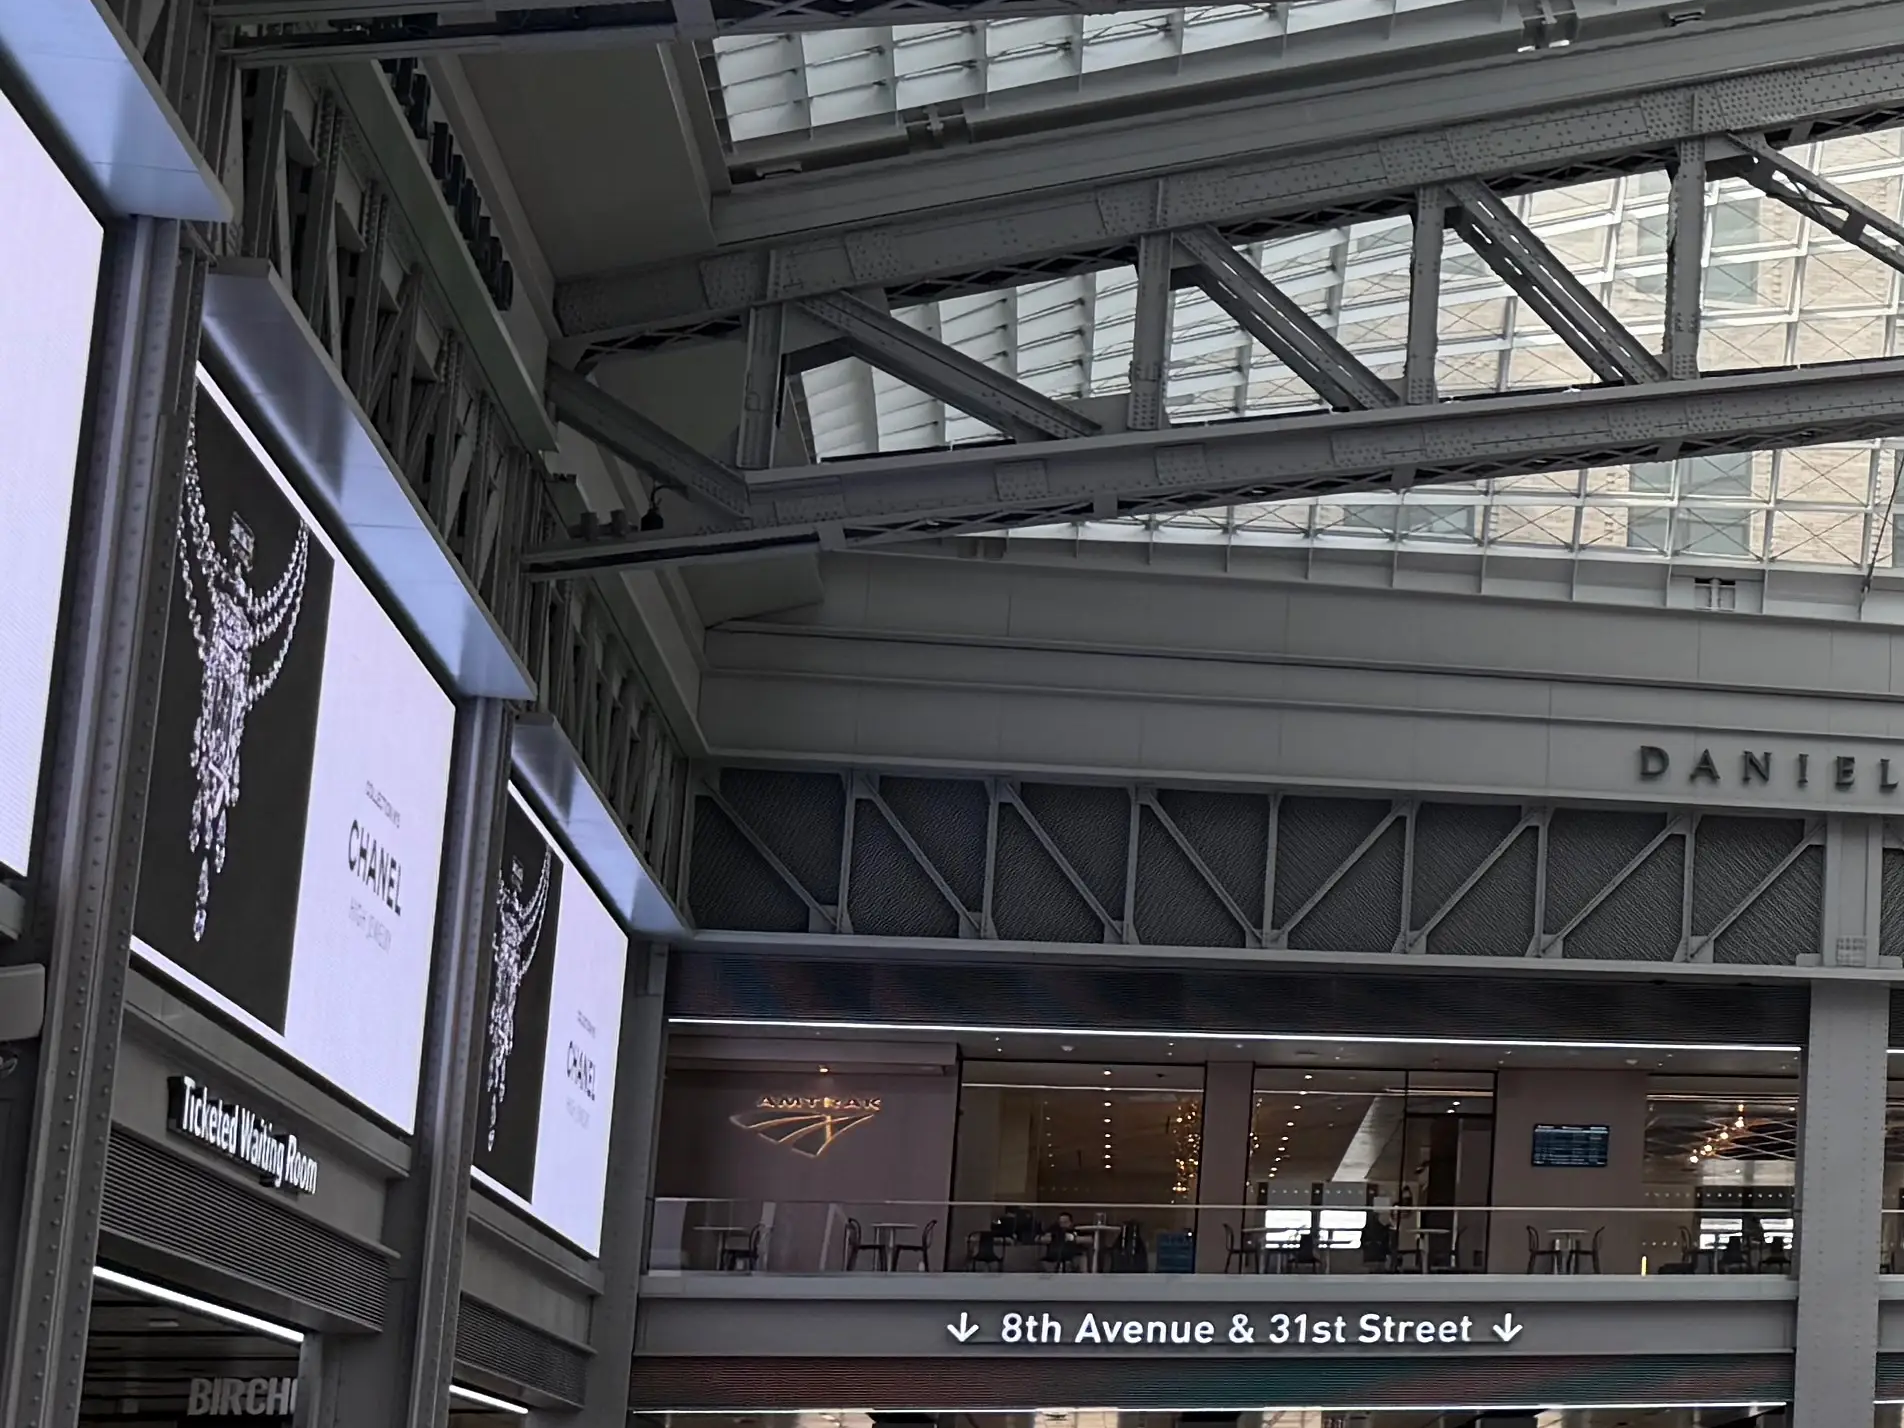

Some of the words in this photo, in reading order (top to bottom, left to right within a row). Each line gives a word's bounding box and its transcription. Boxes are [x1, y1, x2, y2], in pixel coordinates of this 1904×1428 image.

[1639, 745, 1899, 791] DANIEL
[348, 819, 401, 916] CHANEL
[757, 1095, 881, 1111] AMTRAK
[182, 1075, 239, 1154] Ticketed
[240, 1108, 285, 1187] Waiting
[285, 1134, 317, 1195] Room
[1001, 1312, 1062, 1344] 8th
[1074, 1312, 1215, 1344] Avenue
[1228, 1312, 1255, 1344] &
[1268, 1312, 1347, 1344] 31st
[1357, 1312, 1473, 1344] Street
